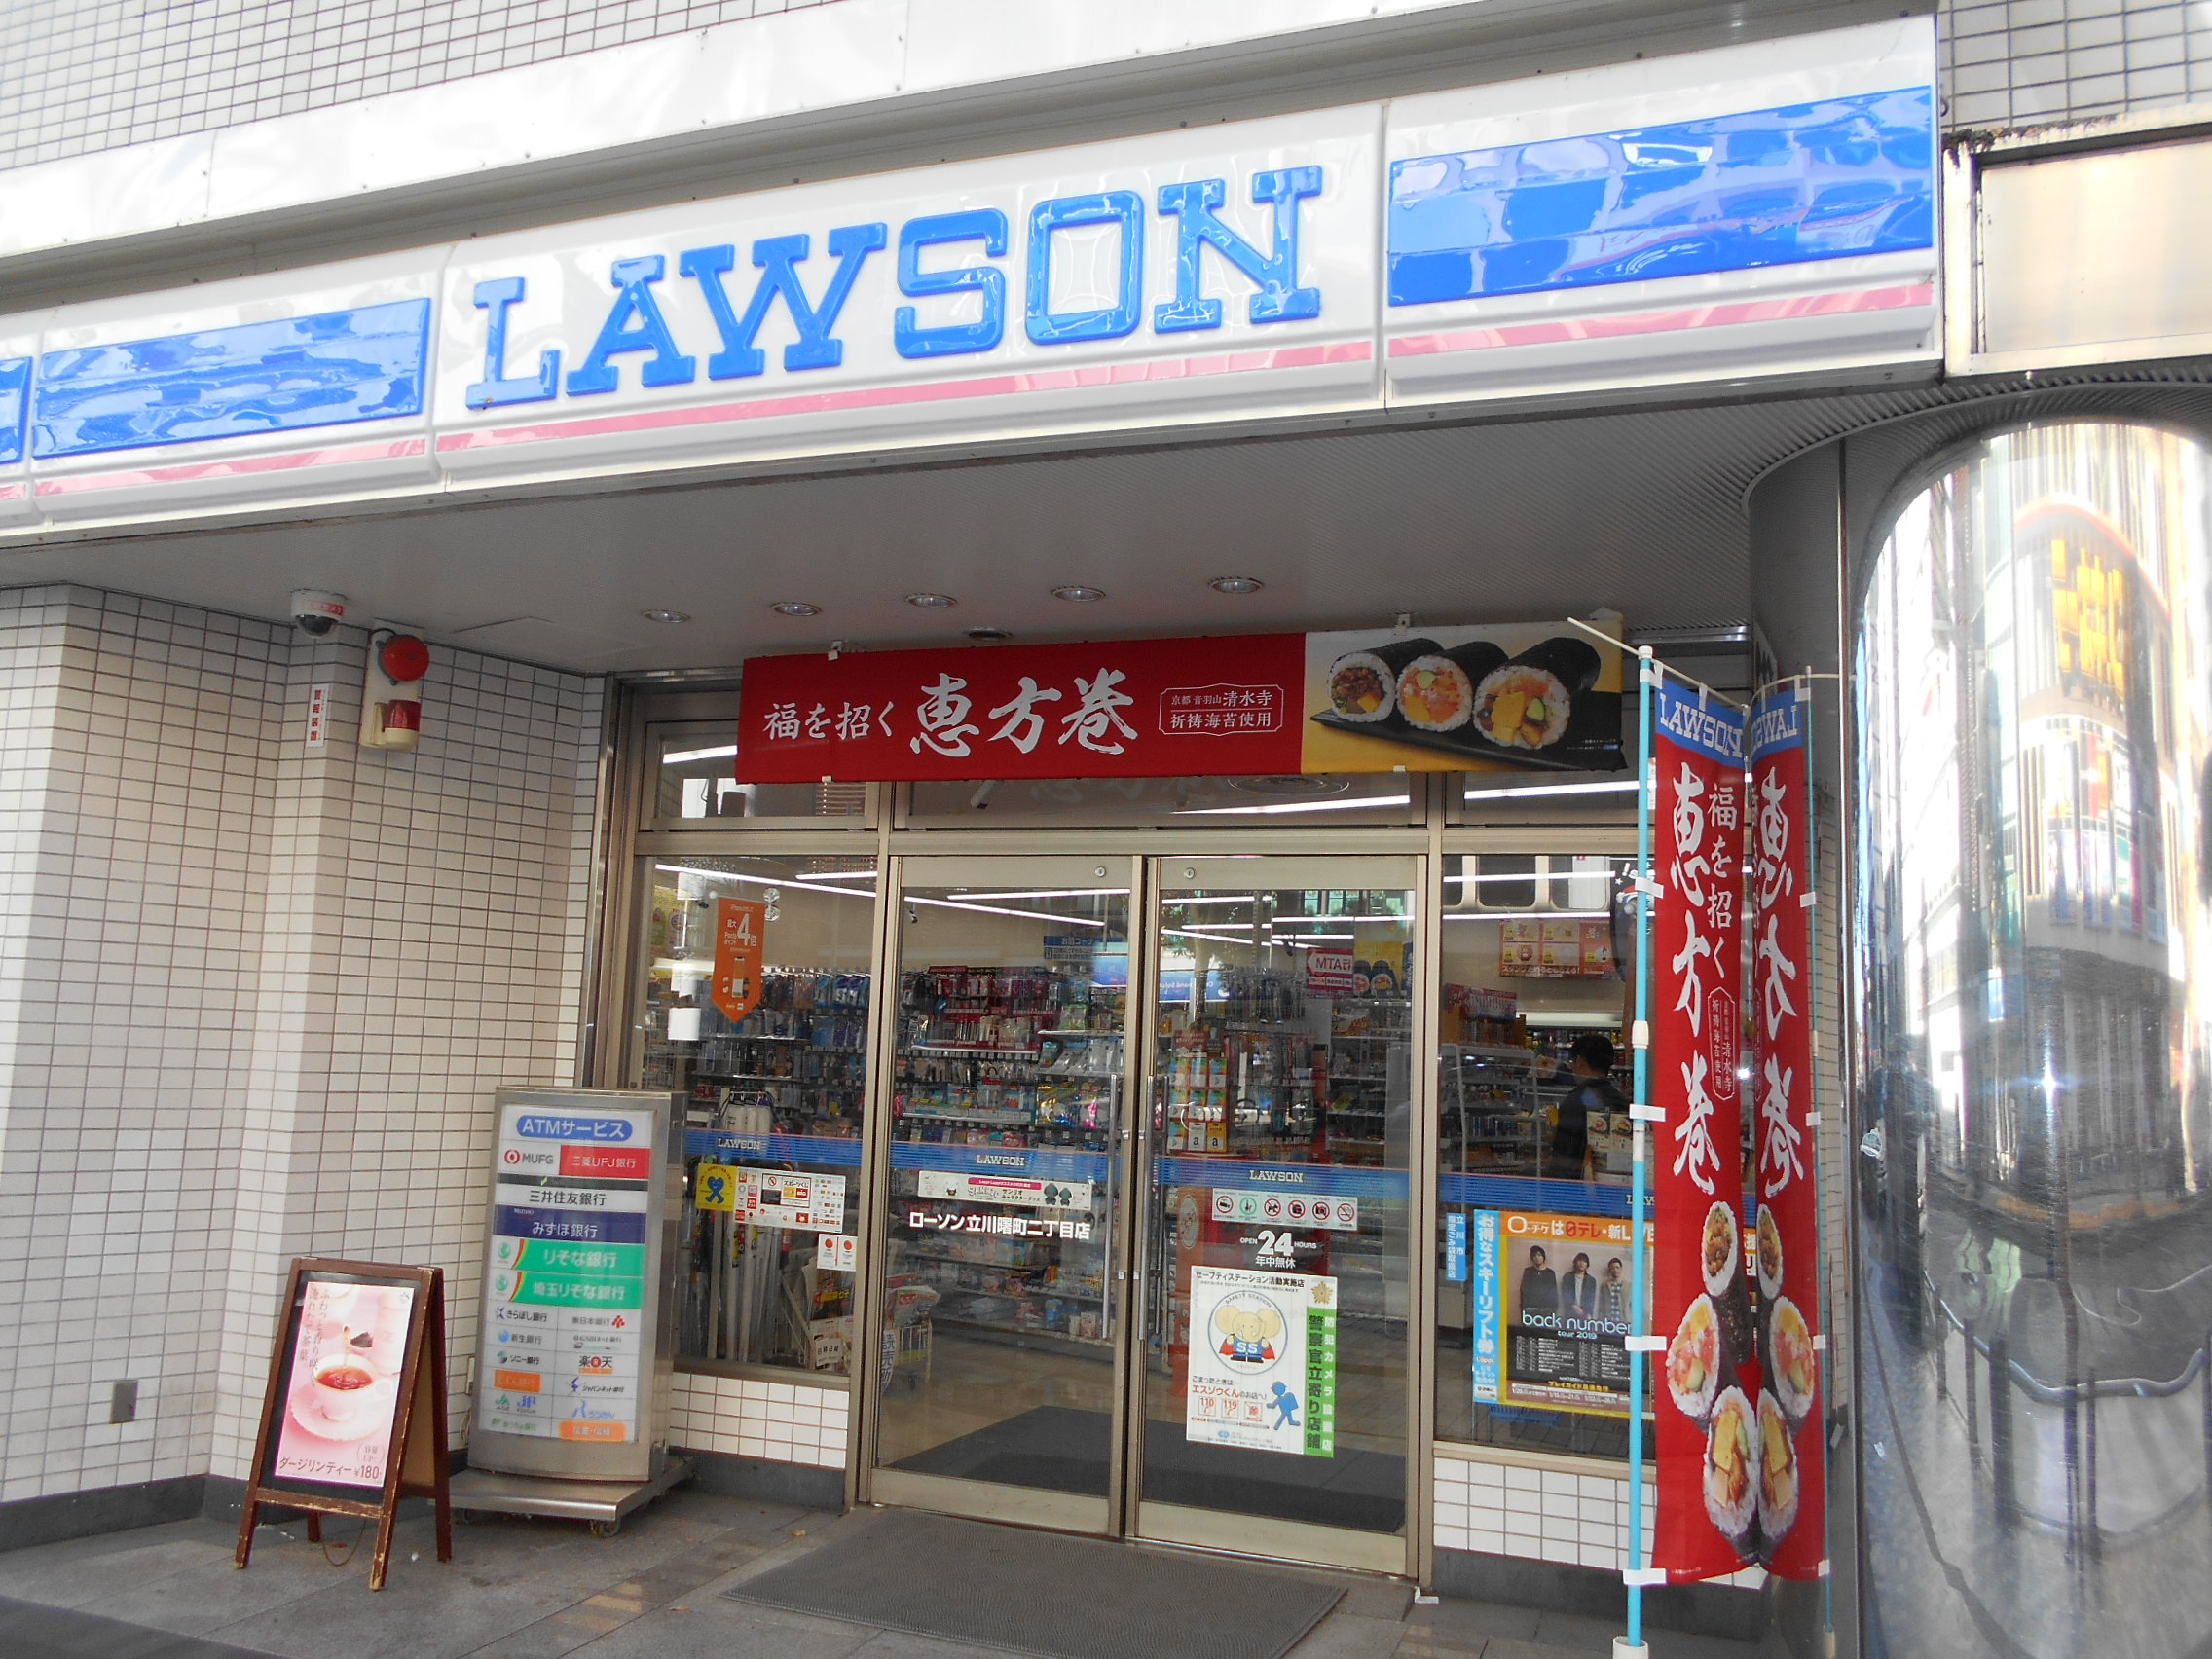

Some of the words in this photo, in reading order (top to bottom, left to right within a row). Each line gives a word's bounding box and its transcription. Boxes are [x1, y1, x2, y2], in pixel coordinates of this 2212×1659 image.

[466, 165, 1322, 410] LAWSON
[763, 700, 895, 743] 福を招く
[909, 667, 1139, 757] 恵方巻
[1169, 709, 1272, 730] 祈祷海苔使用
[1659, 692, 1743, 759] LAWSON
[1707, 783, 1737, 979] 福を招く
[737, 913, 751, 946] 4
[1669, 761, 1721, 1196] 恵方巻
[522, 1119, 626, 1139] ATMサービス
[717, 1138, 762, 1151] LAWSON
[521, 1154, 554, 1165] MUFG
[572, 1155, 637, 1169] 三菱UFJ銀行
[977, 1154, 1025, 1166] LAWSON
[1249, 1169, 1304, 1183] LAWSON
[529, 1190, 607, 1206] 三井住友銀行
[532, 1221, 599, 1239] みずほ銀行
[909, 1211, 1091, 1240] ローソン立川曙町二丁目店
[1239, 1237, 1258, 1246] OPEN
[1257, 1230, 1294, 1257] 24
[544, 1249, 618, 1268] りそな銀行
[1255, 1256, 1297, 1270] 年中無休
[533, 1281, 625, 1301] 埼玉りそな銀行
[506, 1310, 547, 1323] きらぼし銀行
[1522, 1310, 1562, 1329] back
[1576, 1331, 1598, 1340] 2019
[1236, 1342, 1258, 1354] SS
[1199, 1396, 1215, 1407] 110
[1223, 1399, 1237, 1409] 119
[279, 1456, 351, 1473] ダージリンティー
